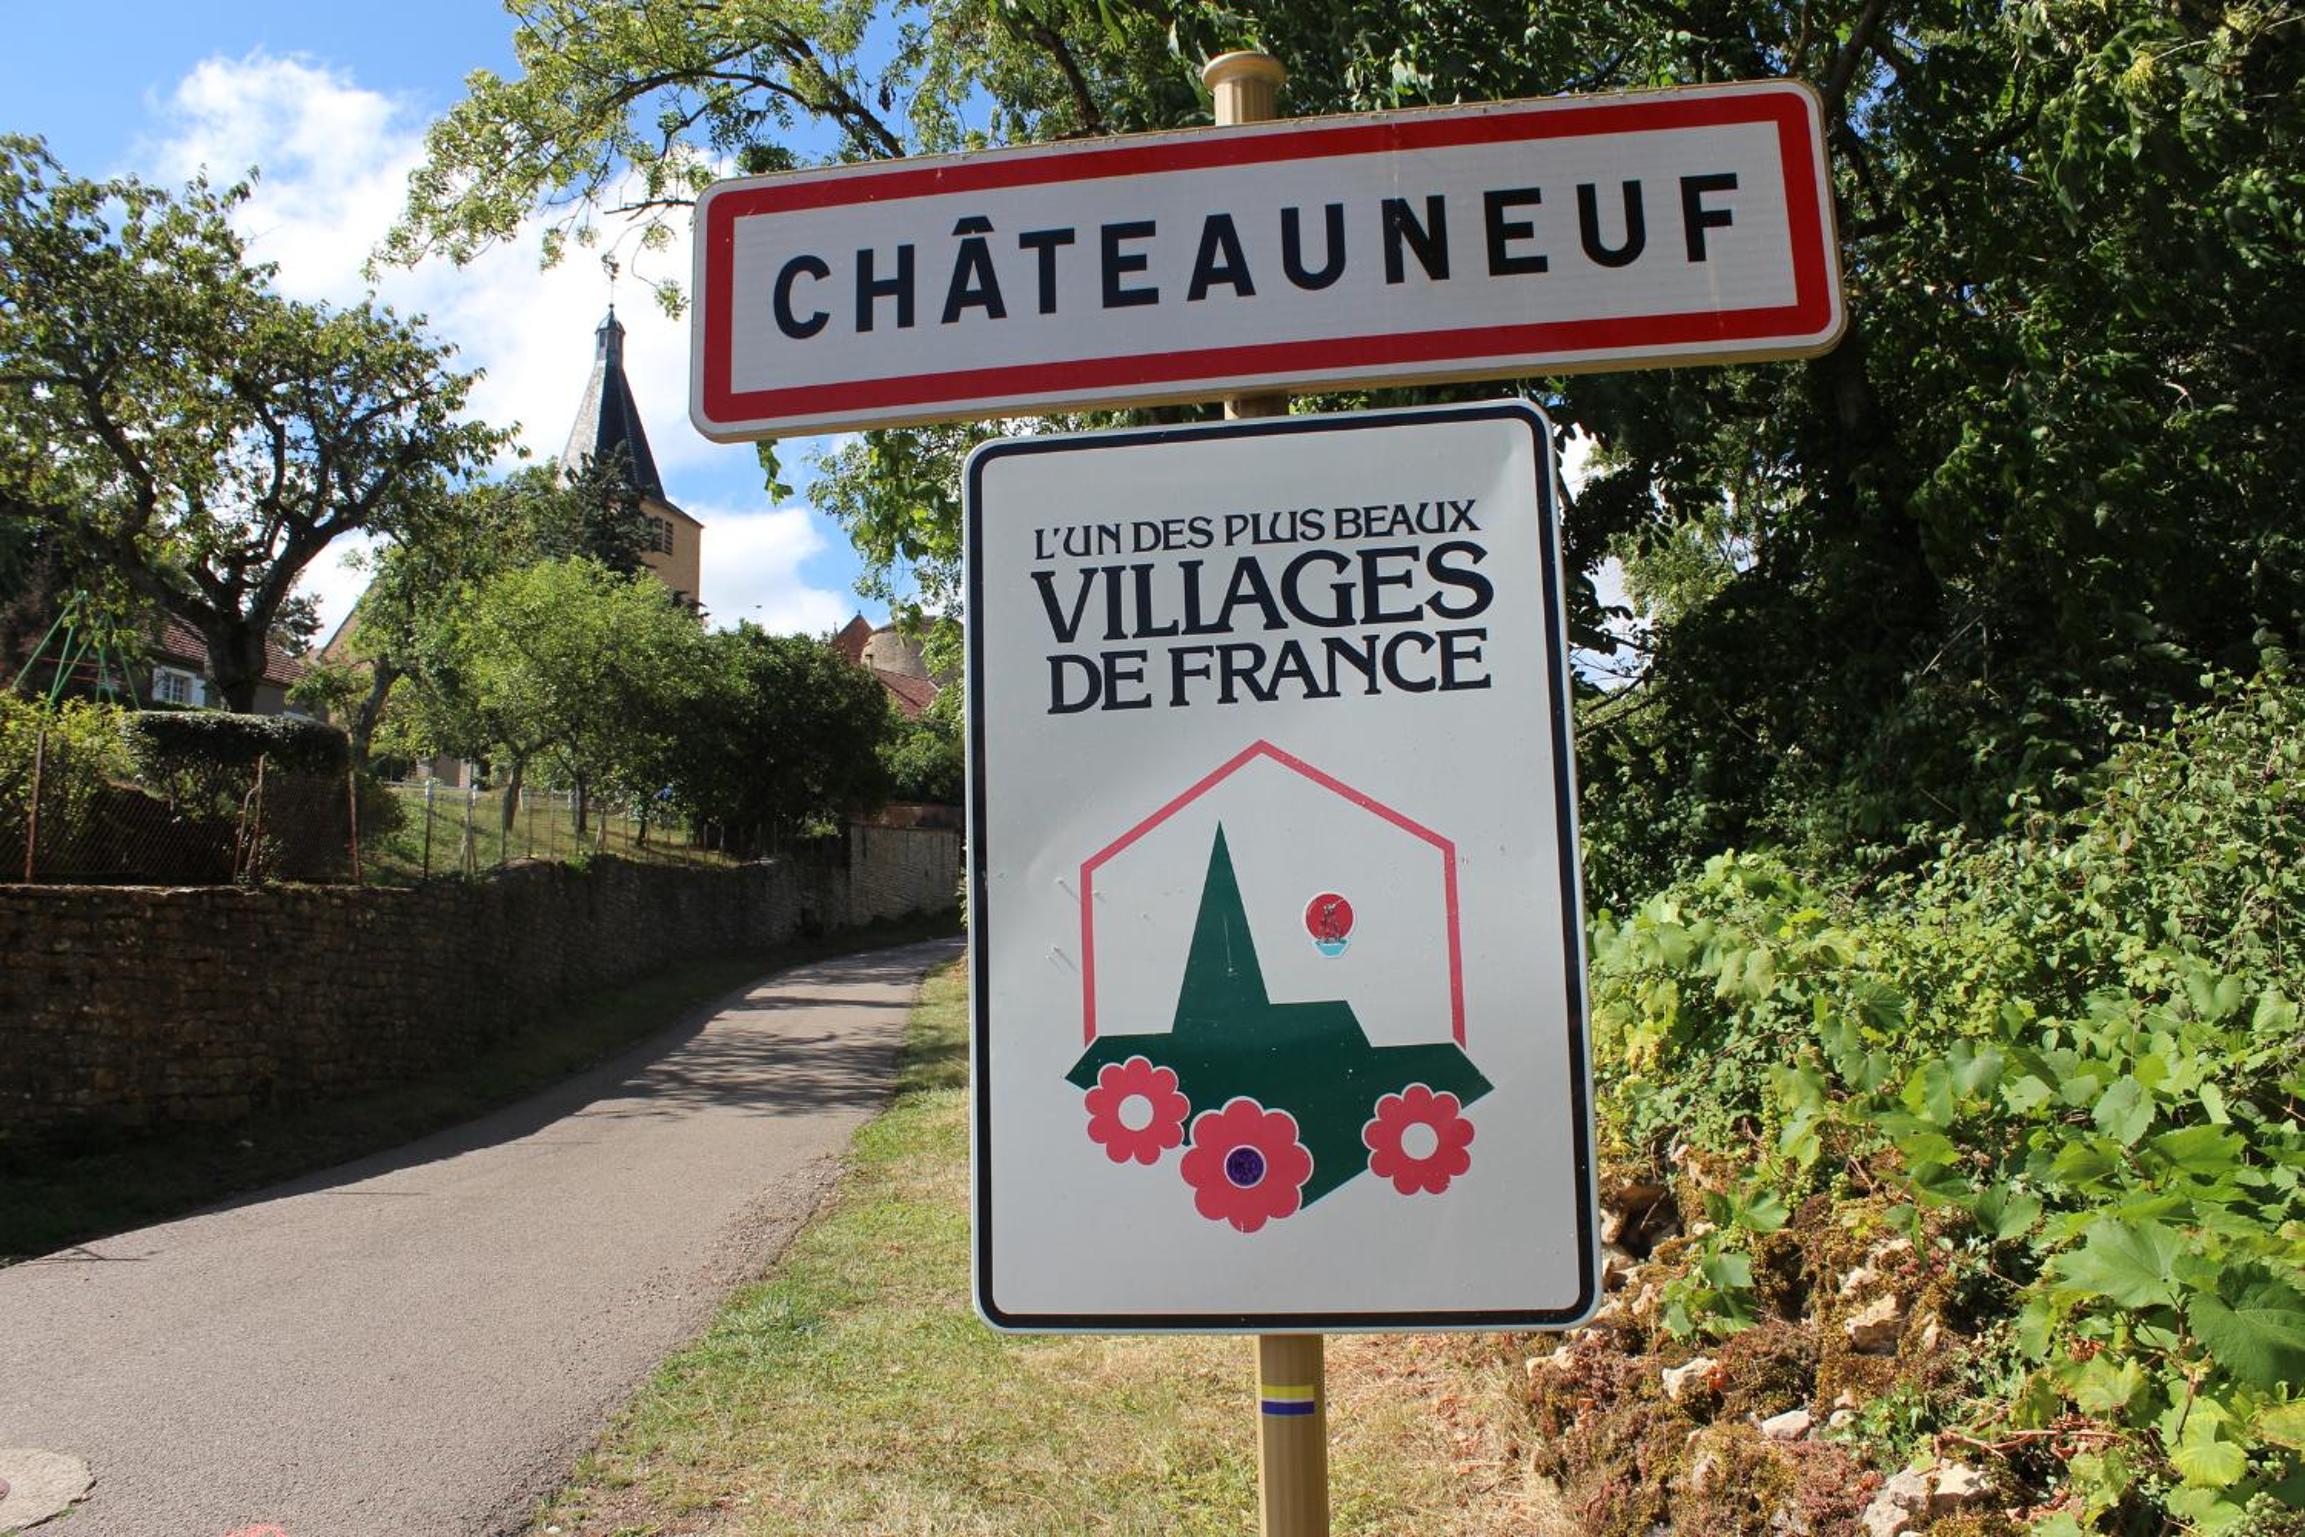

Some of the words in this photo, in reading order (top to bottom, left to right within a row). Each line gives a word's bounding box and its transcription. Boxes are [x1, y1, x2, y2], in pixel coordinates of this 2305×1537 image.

[772, 172, 1739, 340] CHÂTEAUNEUF
[1034, 523, 1121, 560] L'UN
[1132, 516, 1214, 552] DES
[1224, 508, 1326, 546] PLUS
[1334, 499, 1482, 539] BEAUX
[1030, 540, 1494, 643] VILLAGES
[1046, 649, 1152, 714] DE
[1168, 627, 1492, 707] FRANCE
